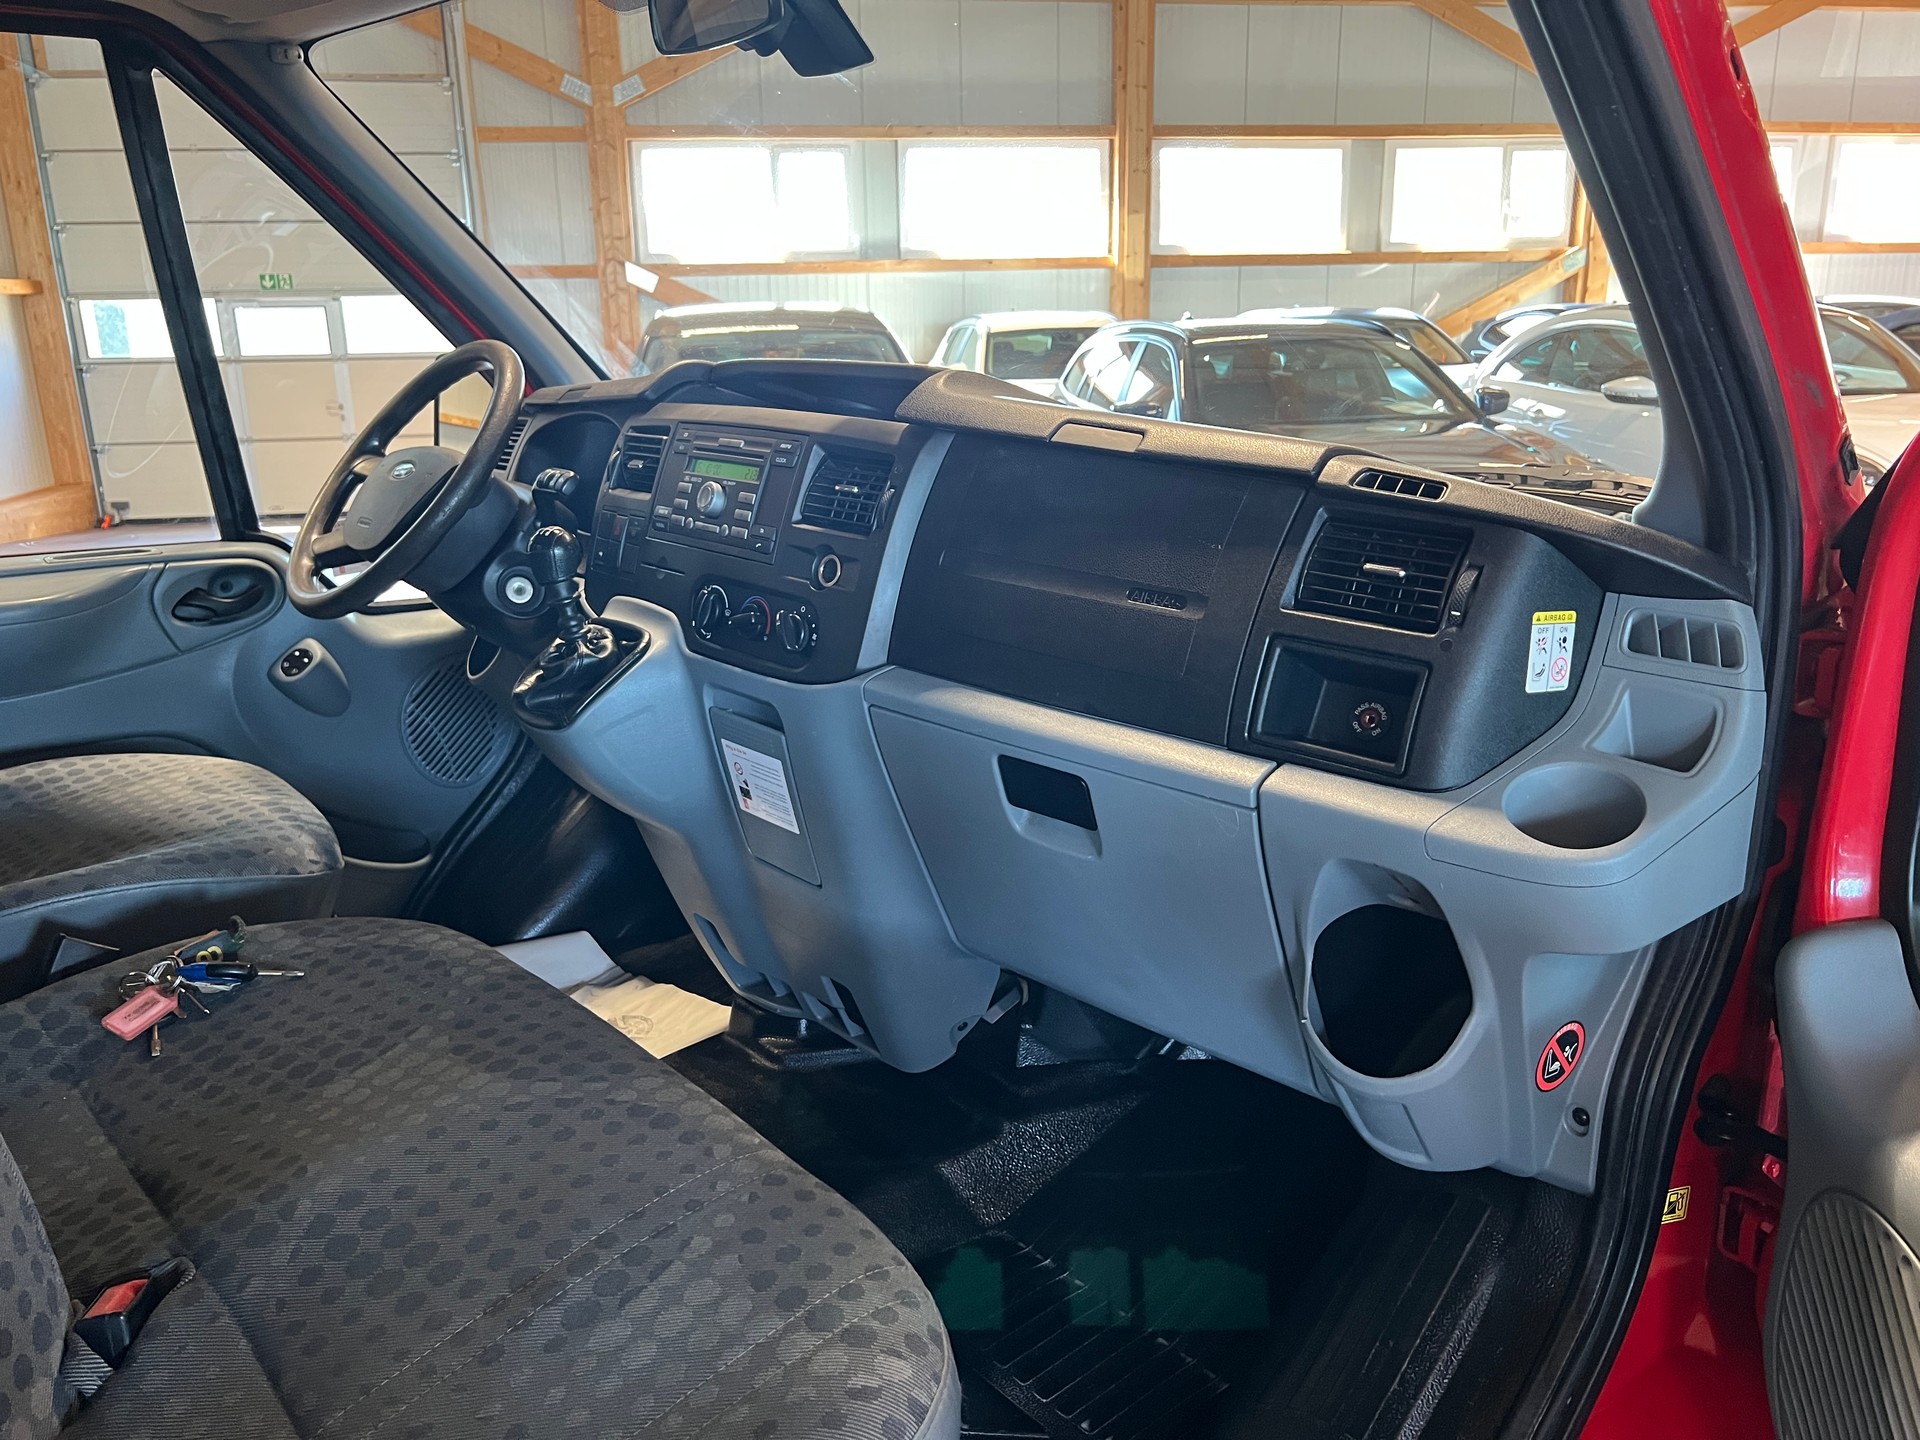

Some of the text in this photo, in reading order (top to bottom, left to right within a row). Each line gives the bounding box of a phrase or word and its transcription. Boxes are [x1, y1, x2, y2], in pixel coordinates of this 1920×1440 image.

[1543, 613, 1566, 622] AIRBAG
[1537, 627, 1549, 635] OFF
[1354, 701, 1388, 721] PASS AIRBAG
[1352, 721, 1363, 733] OFF
[1371, 727, 1382, 737] ON
